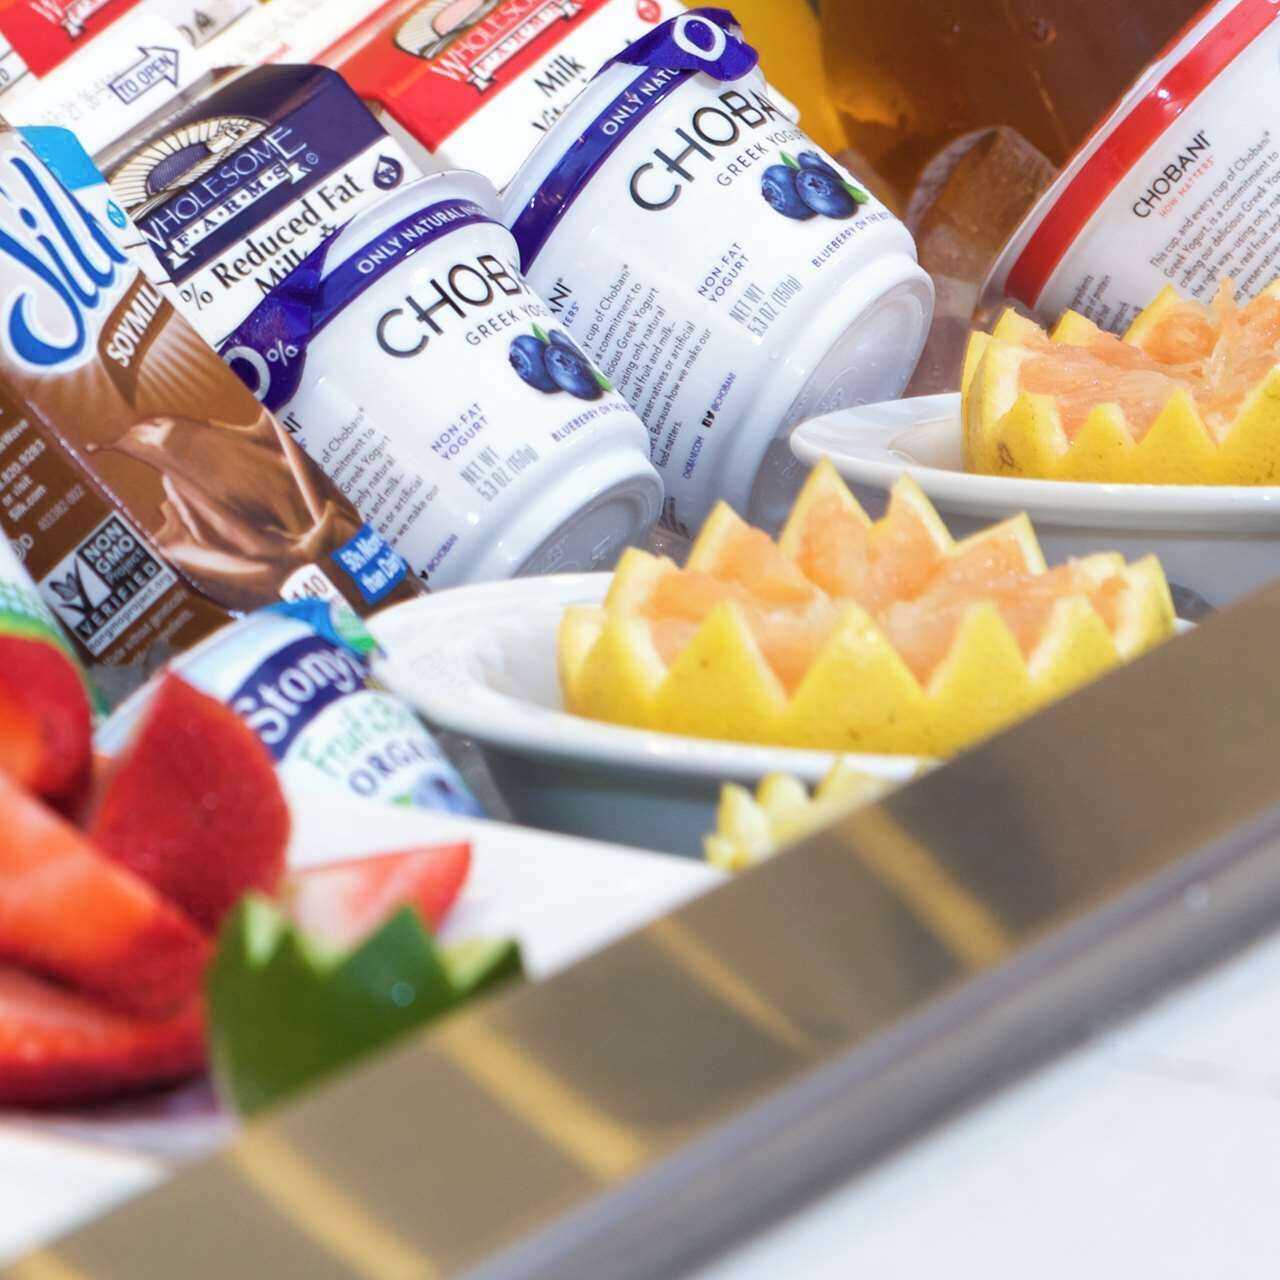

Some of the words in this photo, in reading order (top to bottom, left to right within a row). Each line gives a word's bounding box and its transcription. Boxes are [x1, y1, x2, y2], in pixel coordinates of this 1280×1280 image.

[117, 73, 140, 98] TO
[136, 54, 171, 85] OPEN
[534, 53, 586, 98] Milk
[602, 91, 645, 136] ONLY
[629, 90, 791, 212] CHOBA
[717, 141, 770, 187] GREEK
[1131, 132, 1211, 220] CHOBANI
[1160, 197, 1179, 218] HOW
[1177, 156, 1215, 198] MATTERS
[1149, 251, 1168, 269] This
[1178, 216, 1195, 237] and
[1191, 195, 1216, 221] every
[1211, 178, 1230, 199] cup
[1226, 166, 1238, 183] of
[1234, 136, 1271, 172] Chobani
[1163, 253, 1186, 279] Greek
[1220, 160, 1271, 213] commitment
[1267, 150, 1280, 164] to
[1211, 211, 1246, 249] delicious
[1240, 185, 1267, 213] Greek
[1253, 206, 1272, 227] only
[211, 192, 319, 290] Reduced
[317, 171, 366, 214] Fat
[811, 226, 857, 268] BLUEBERRY
[358, 237, 403, 275] ONLY
[698, 242, 743, 298] NON-FAT
[708, 253, 751, 304] YOGURT
[599, 270, 632, 312] Chobani
[729, 298, 752, 325] NET
[743, 282, 766, 307] WT
[107, 285, 161, 366] SOYMIL
[466, 310, 521, 347] GREEK
[586, 324, 602, 344] cup
[595, 310, 606, 323] of
[598, 294, 635, 354] commitment
[631, 282, 643, 296] to
[616, 319, 640, 350] Greek
[632, 286, 660, 321] Yogurt
[632, 339, 649, 362] only
[642, 305, 667, 342] natural
[670, 319, 697, 360] artificial
[747, 314, 769, 338] 5.3
[758, 300, 776, 322] OZ
[631, 380, 644, 402] real
[639, 363, 654, 384] fruit
[649, 345, 663, 366] and
[650, 393, 671, 436] Because
[669, 381, 681, 404] how
[683, 343, 702, 371] make
[698, 326, 713, 346] our
[430, 401, 483, 453] NON-FAT
[441, 415, 489, 462] YOGURT
[550, 408, 599, 443] BLUEBERRY
[340, 466, 366, 495] Greek
[459, 459, 483, 486] NET
[79, 521, 117, 558] NON
[91, 531, 129, 571] GMO
[76, 558, 150, 626] VERIFIED
